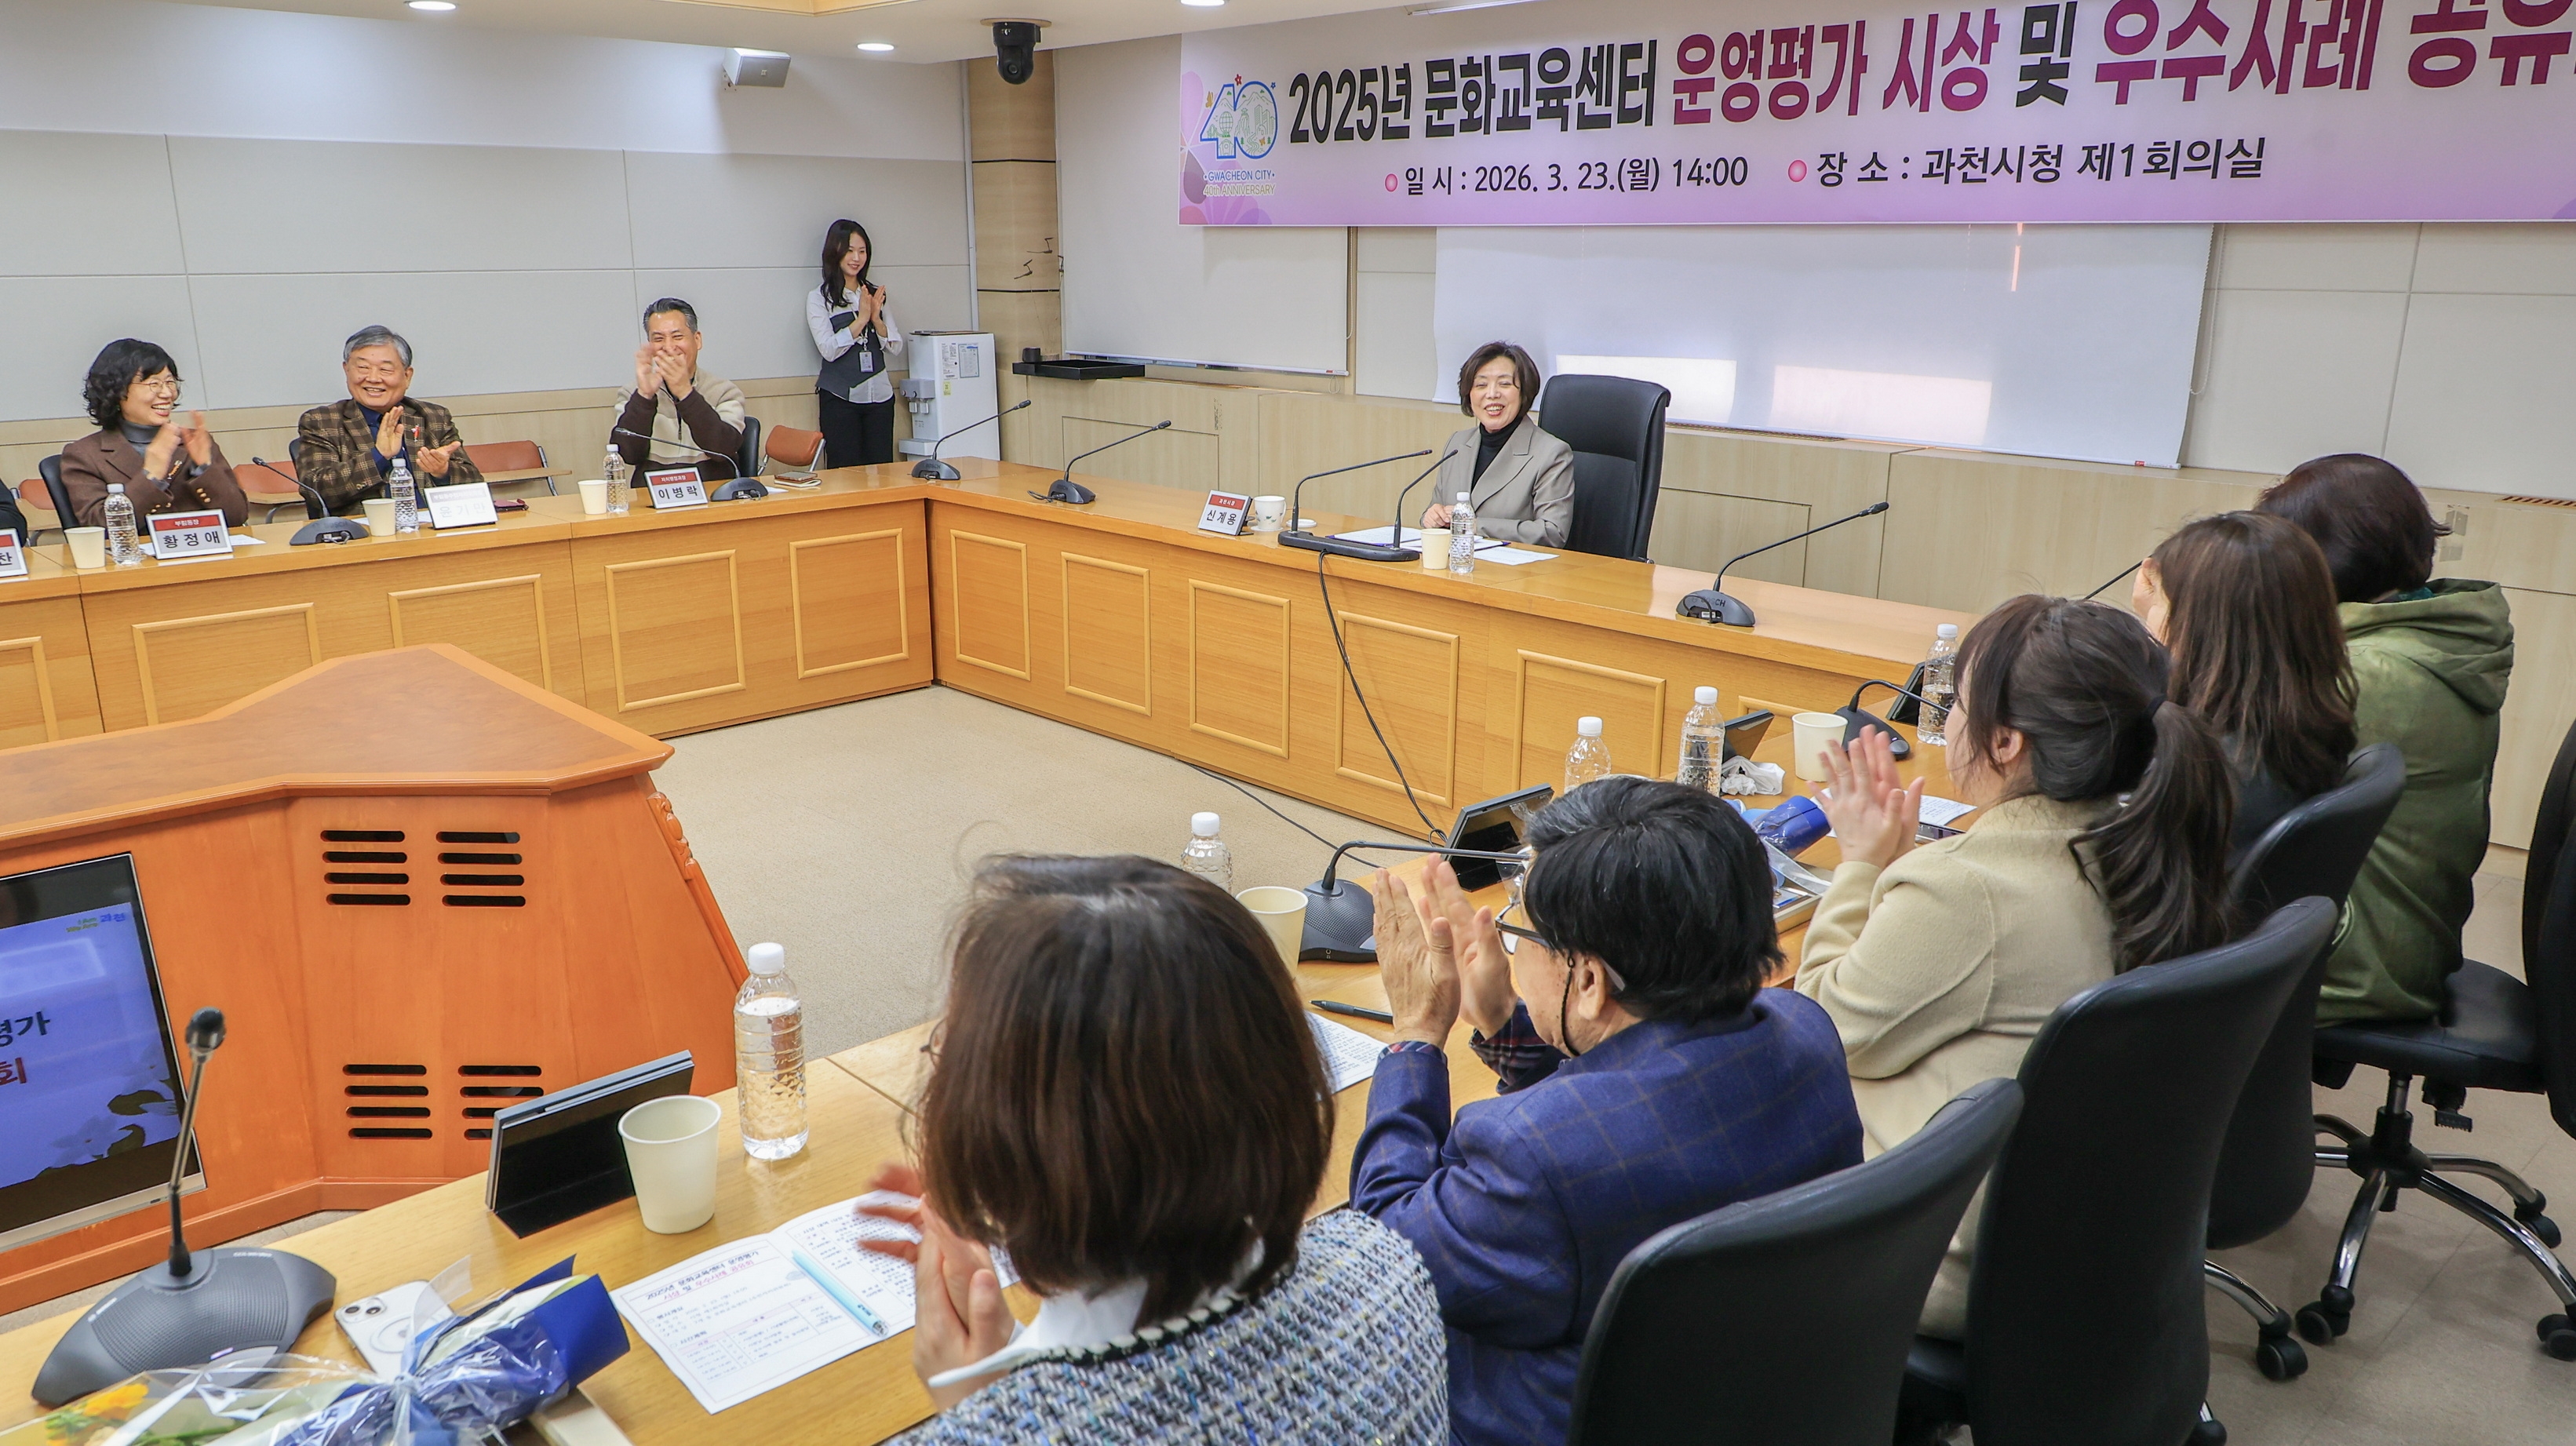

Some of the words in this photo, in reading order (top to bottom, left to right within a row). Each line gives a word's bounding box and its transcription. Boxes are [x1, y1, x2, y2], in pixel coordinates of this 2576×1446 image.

[1288, 62, 1412, 144] 2025년
[1424, 38, 1658, 138] 문화교육센터
[1673, 20, 1870, 126] 운영평가
[1882, 8, 2001, 113] 시상
[2015, 0, 2079, 107] 및
[2093, 0, 2382, 105] 우수사례
[1255, 169, 1272, 180] CITY
[1474, 163, 1538, 193] 2026.
[1547, 163, 1566, 192] 3.
[1672, 156, 1748, 188] 14:00
[1921, 144, 2064, 185] 과천시청
[2076, 137, 2266, 182] 제1회의실
[1204, 185, 1220, 195] 40th
[1222, 184, 1276, 195] ANNIVERSARY
